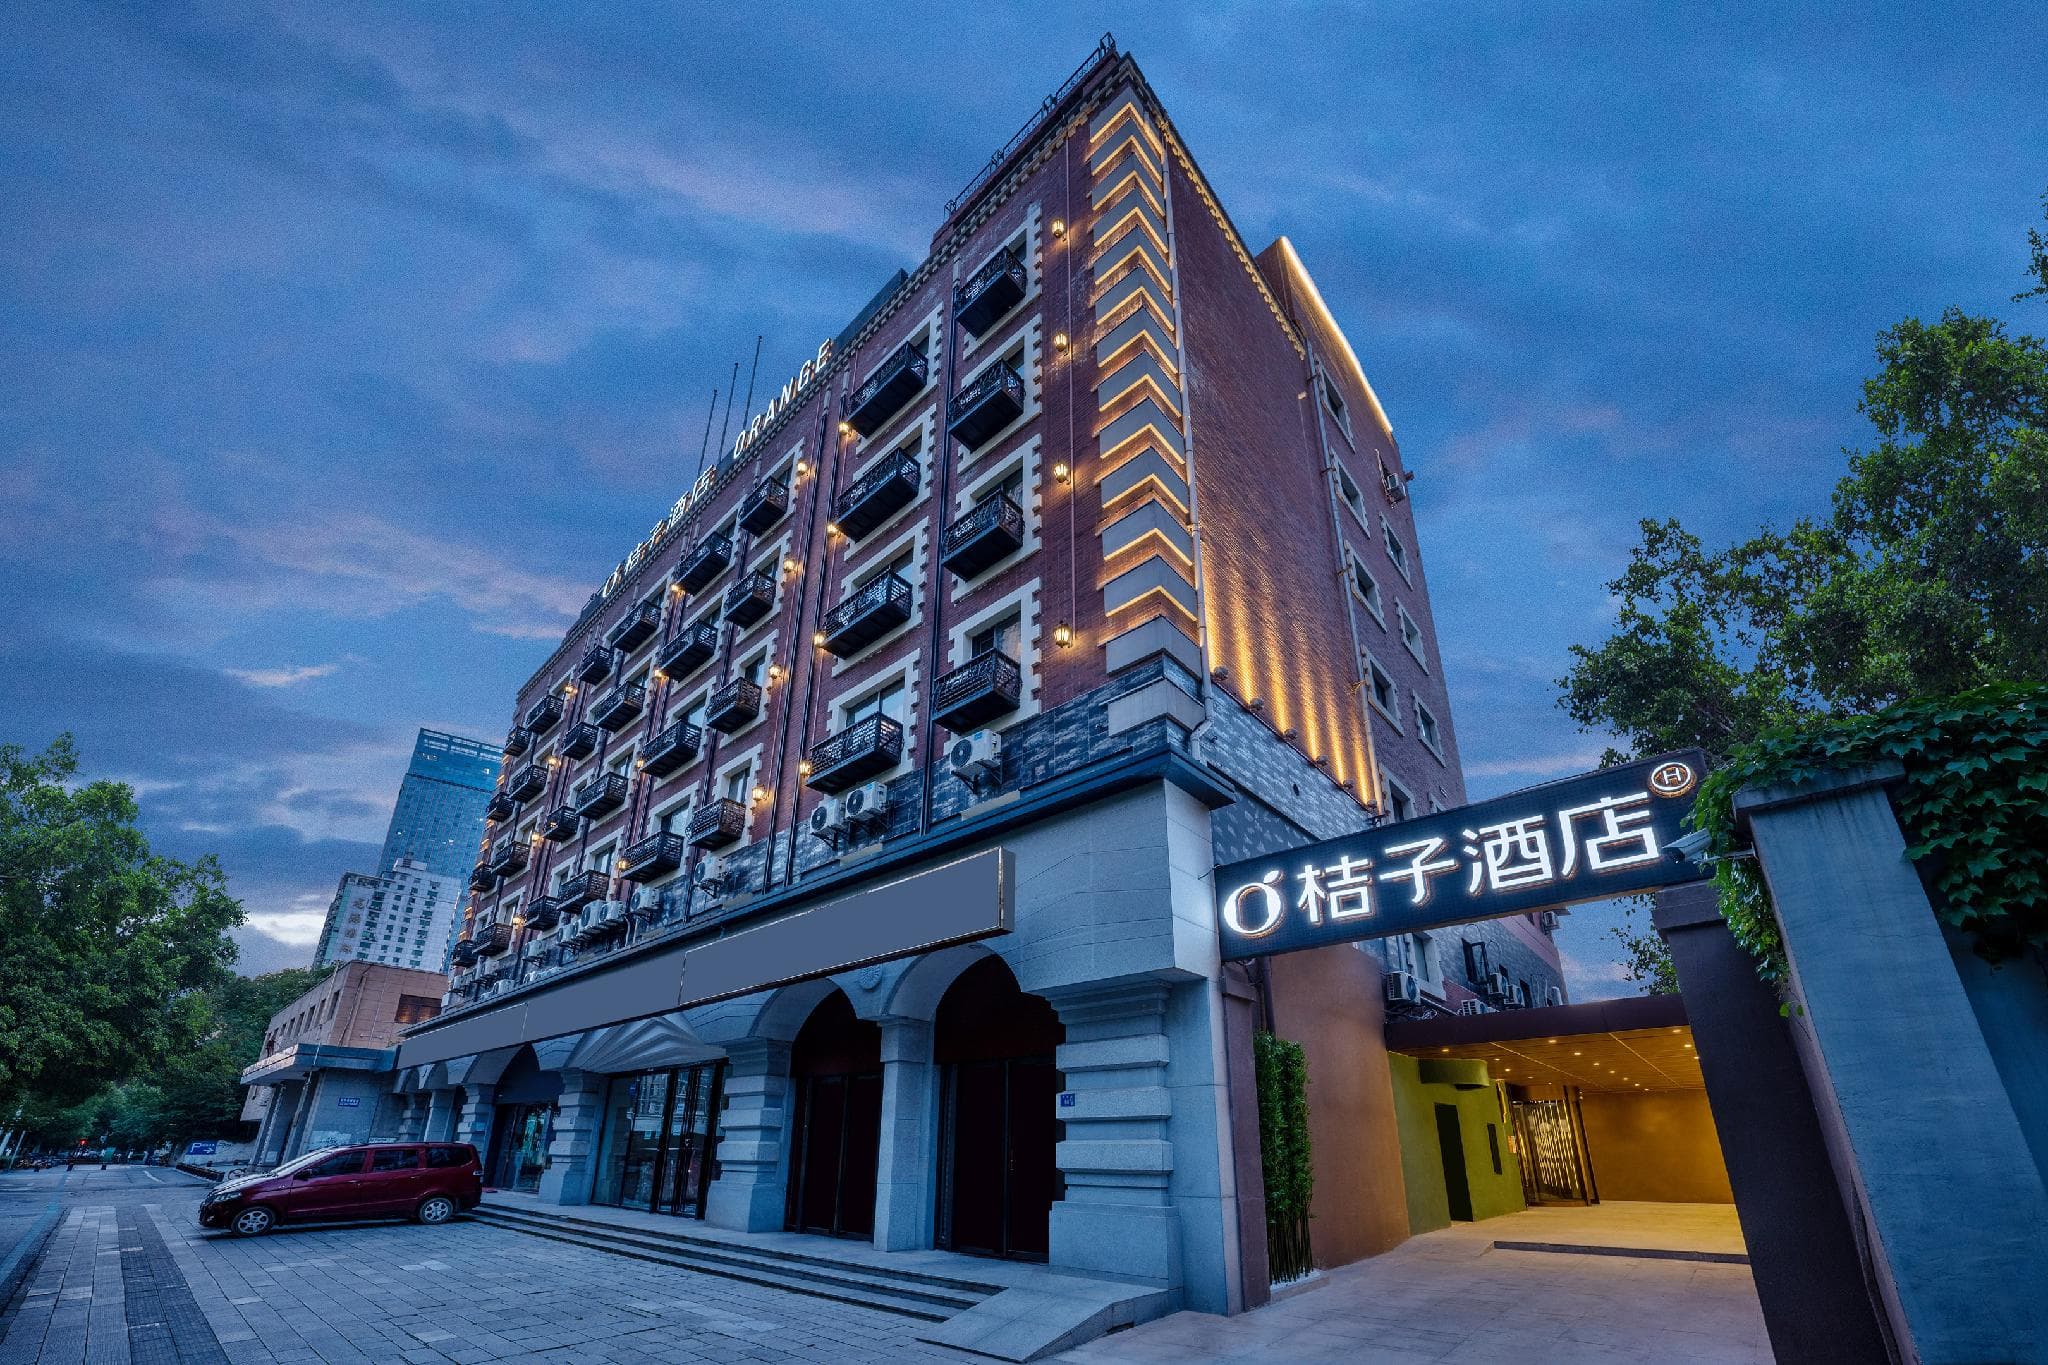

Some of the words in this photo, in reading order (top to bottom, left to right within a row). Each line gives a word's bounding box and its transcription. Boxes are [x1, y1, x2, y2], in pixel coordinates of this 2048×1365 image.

[734, 338, 832, 460] ORANGE
[1297, 791, 1661, 924] 桔子酒店
